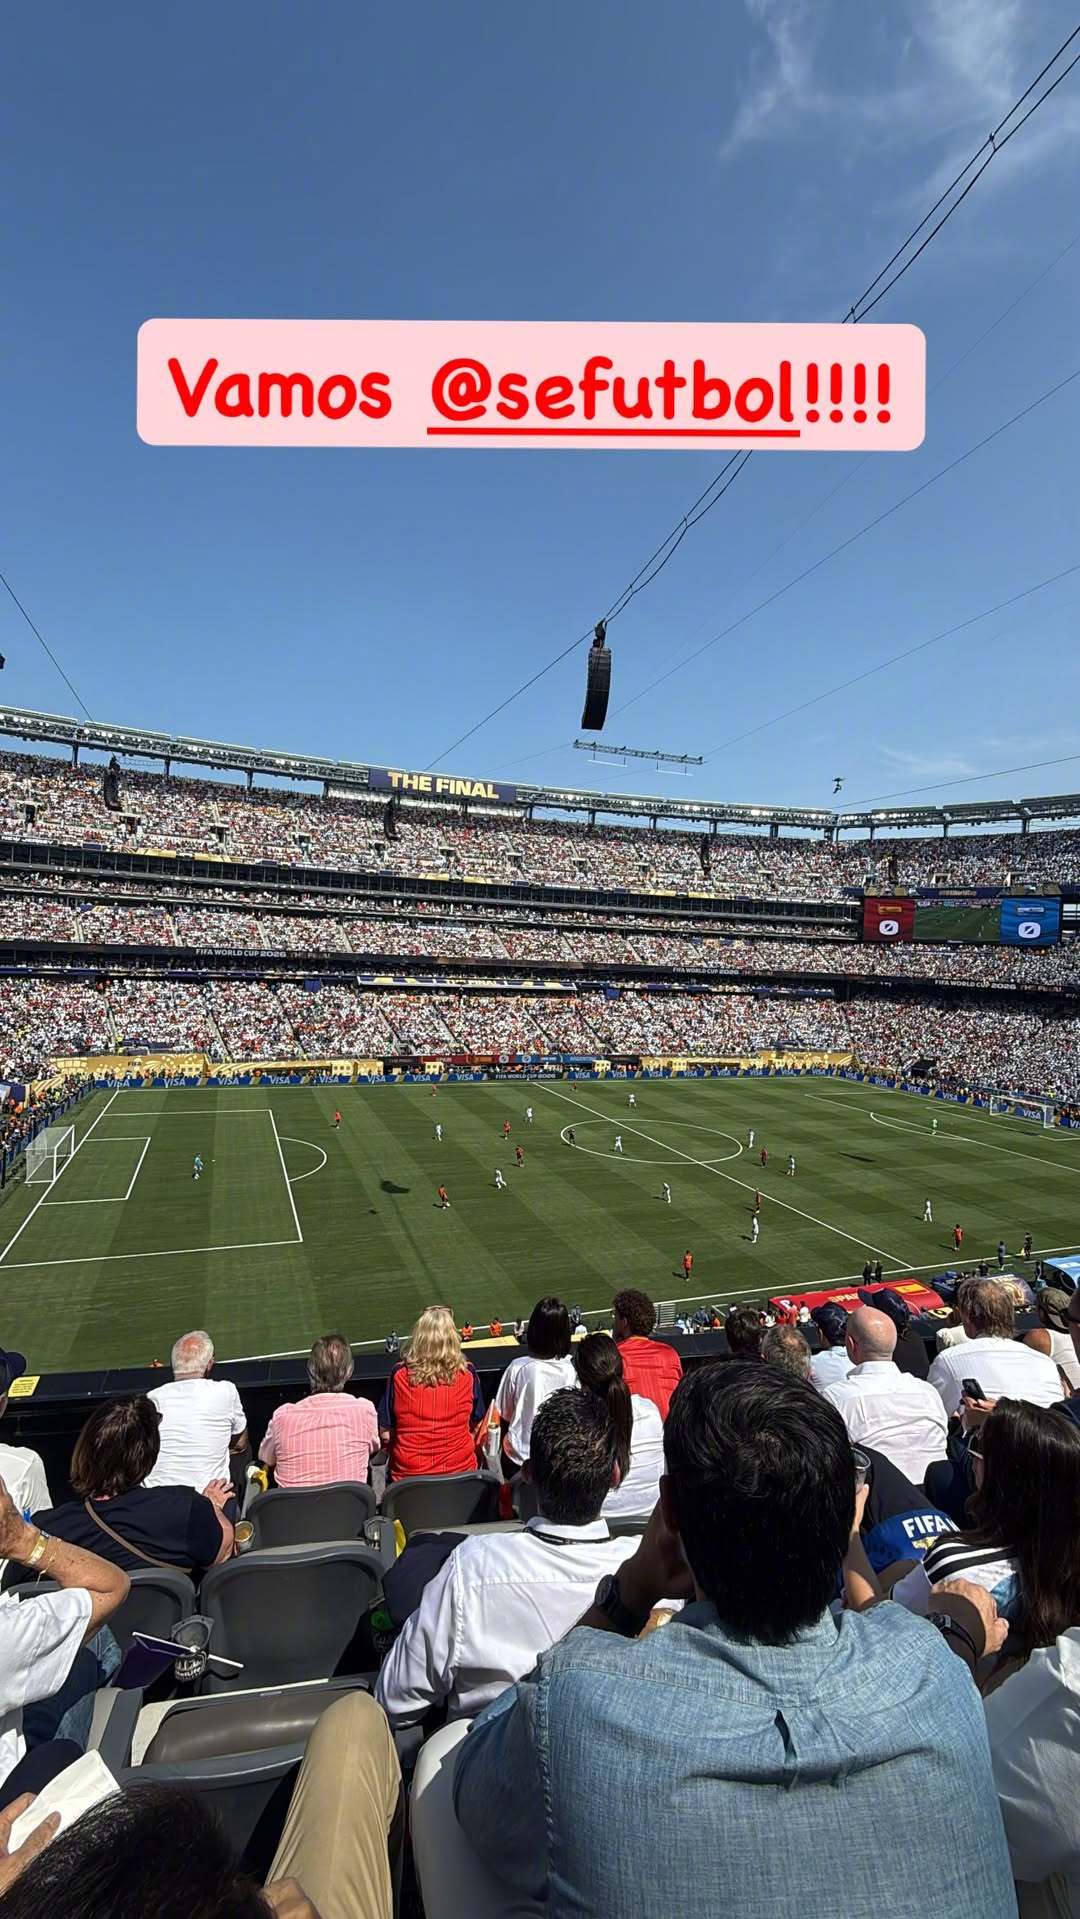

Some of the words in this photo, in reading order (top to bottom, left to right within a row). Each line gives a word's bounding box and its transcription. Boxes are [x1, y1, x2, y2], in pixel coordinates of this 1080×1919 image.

[388, 771, 433, 792] THE
[436, 778, 500, 799] FINAL
[214, 949, 243, 957] WORLD
[950, 980, 976, 988] WORLD
[990, 982, 1017, 990] 2026
[456, 1073, 474, 1081] VISA
[612, 1070, 628, 1078] VISA
[649, 1070, 663, 1078] VISA
[683, 1069, 698, 1077] VISA
[717, 1069, 731, 1077] VISA
[845, 1071, 858, 1080] VISA
[164, 1077, 186, 1087] VISA
[217, 1077, 240, 1085] VISA
[269, 1075, 290, 1084] VISA
[319, 1075, 339, 1083] VISA
[367, 1074, 386, 1083] VISA
[412, 1074, 431, 1082] VISA
[875, 1077, 888, 1087] VISA
[106, 1079, 130, 1088] VISA
[907, 1085, 921, 1094] VISA
[942, 1092, 958, 1101] VISA
[1023, 1110, 1041, 1120] VISA
[902, 1514, 951, 1539] FIFA
